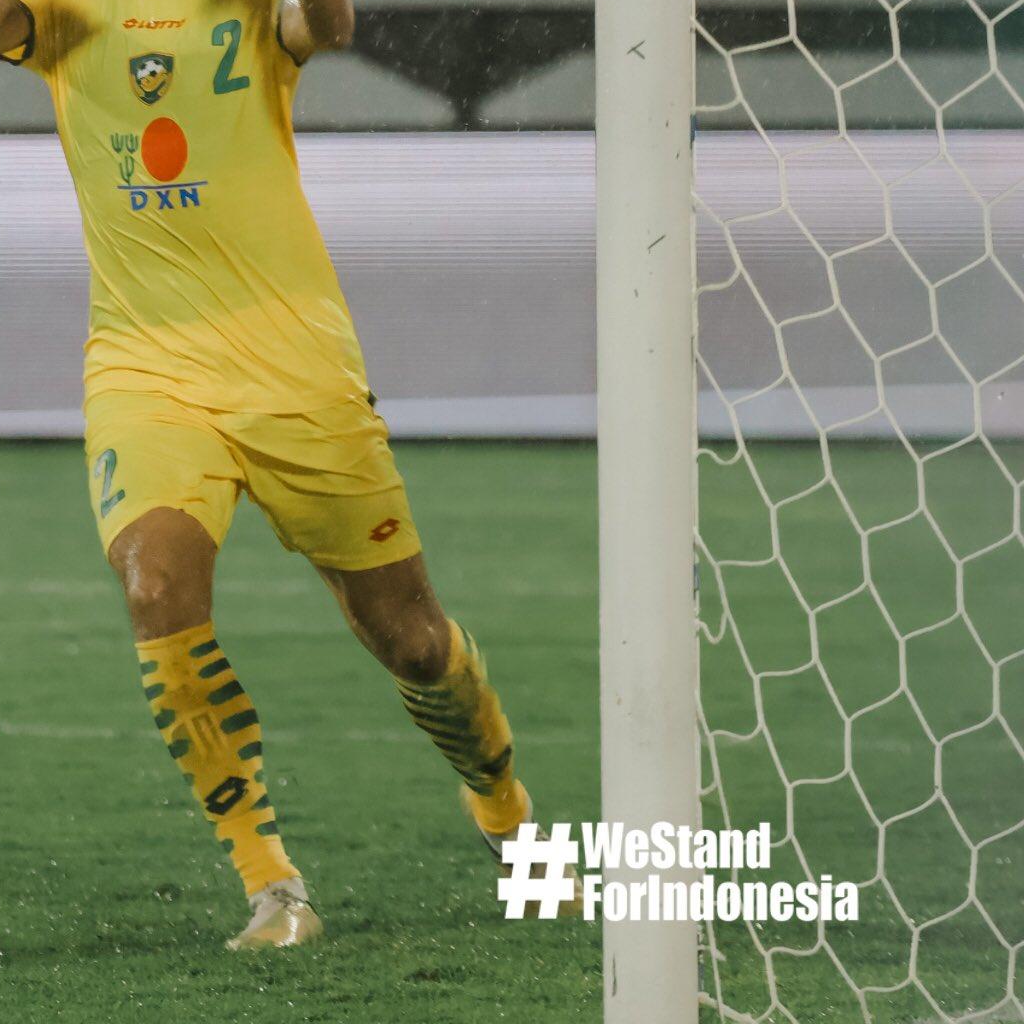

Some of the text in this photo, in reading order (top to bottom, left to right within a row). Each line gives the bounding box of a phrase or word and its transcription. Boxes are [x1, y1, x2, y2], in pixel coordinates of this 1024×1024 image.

[212, 19, 250, 95] 2
[130, 187, 201, 211] DXN
[95, 448, 126, 518] 2
